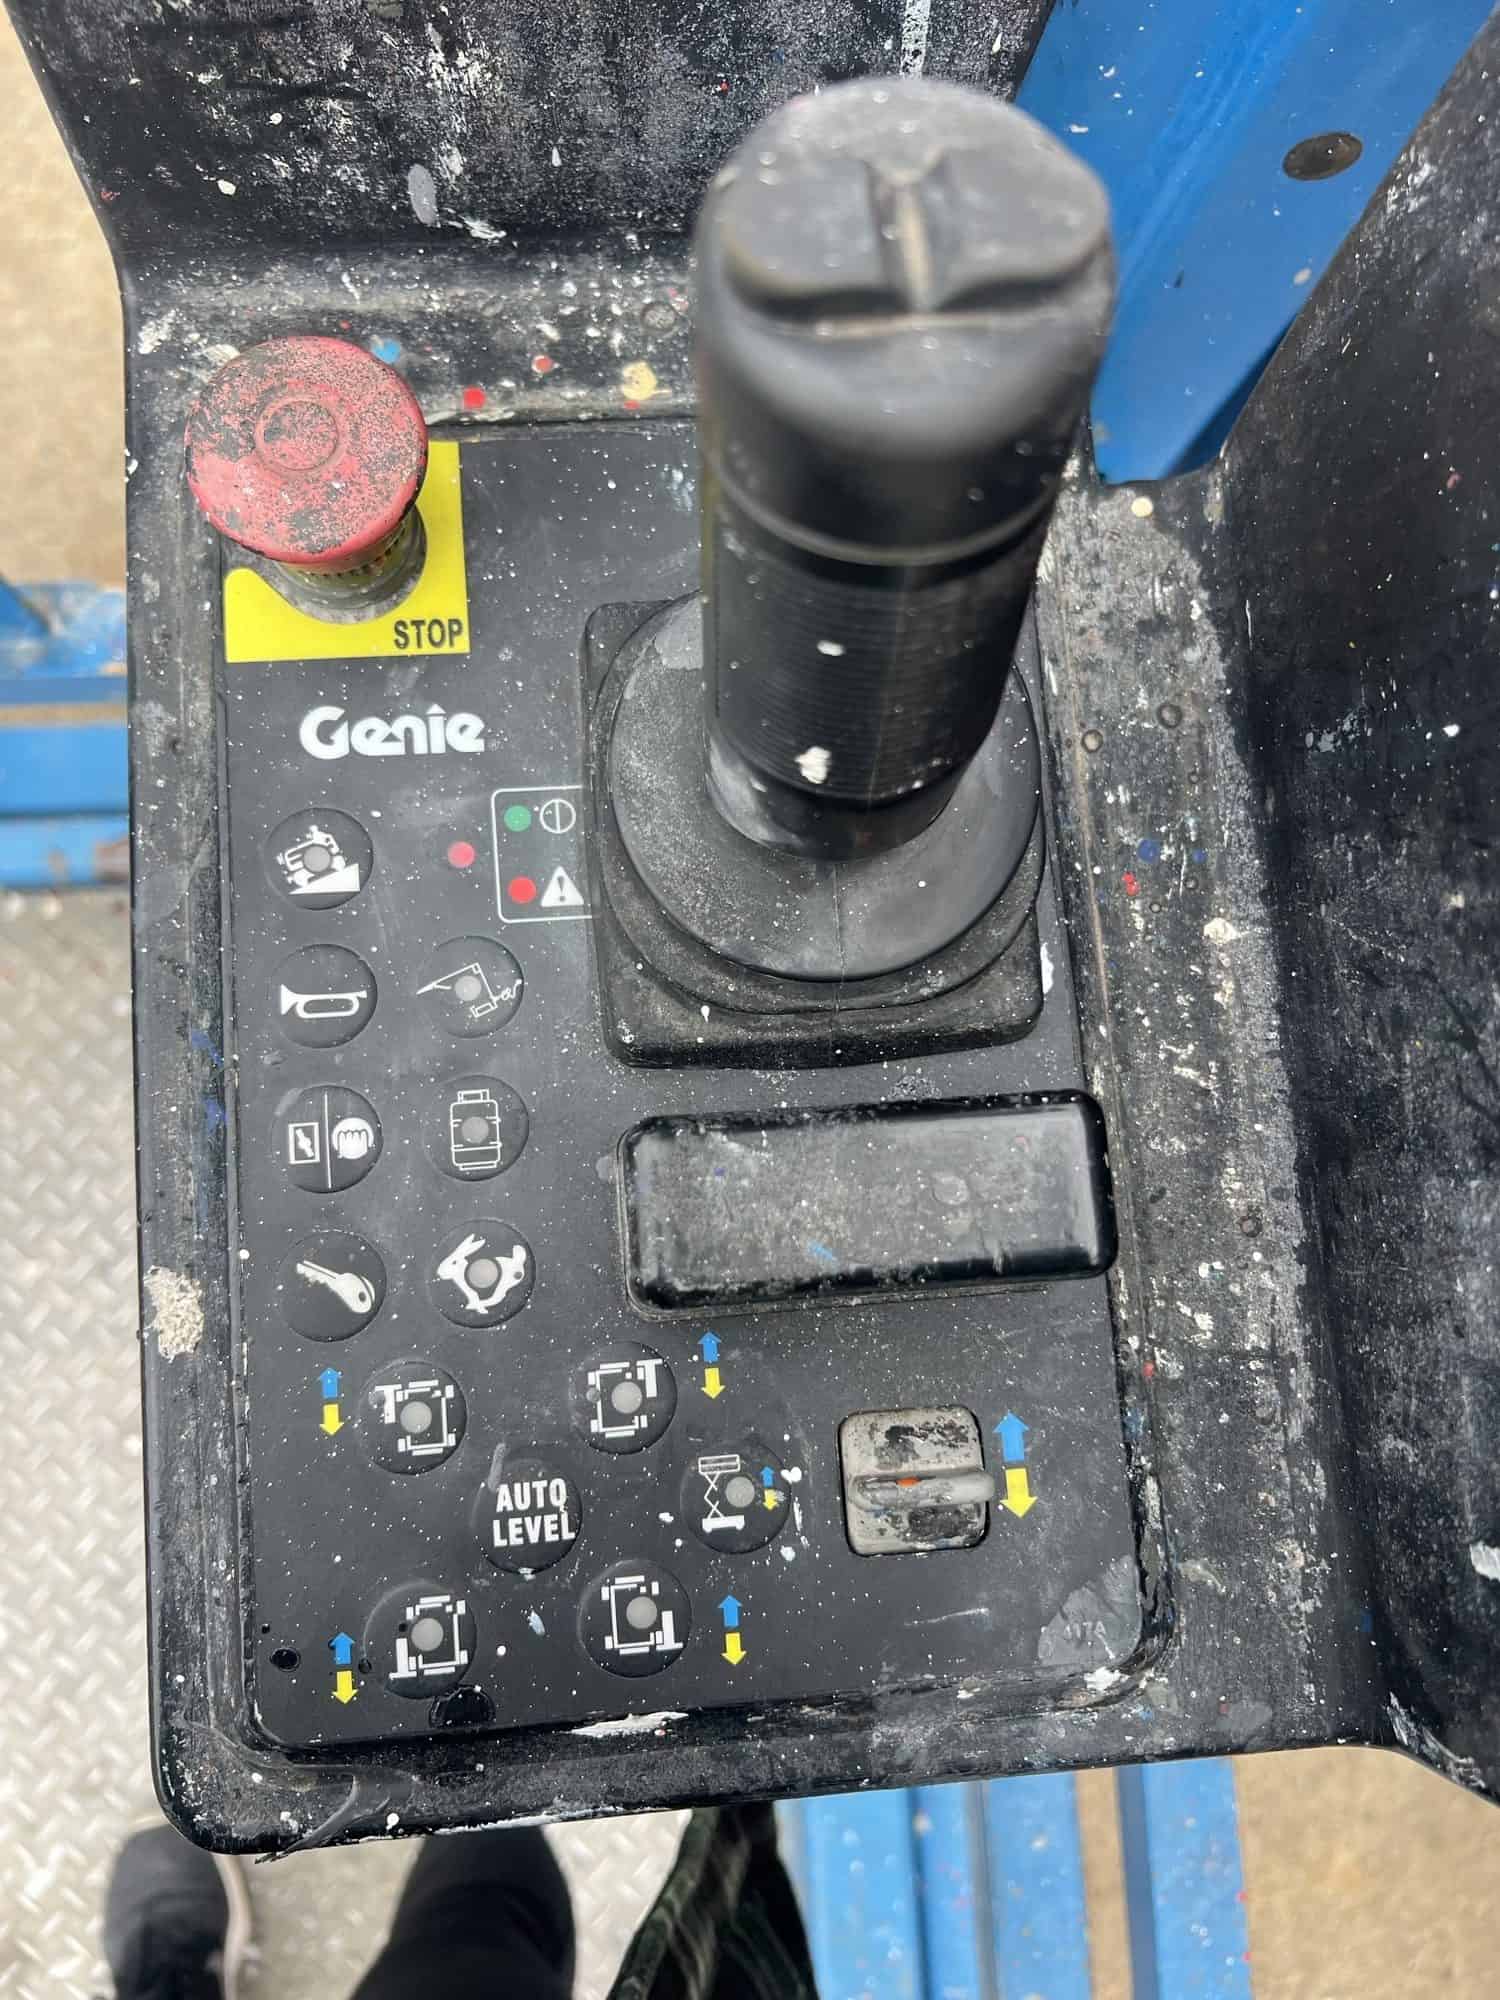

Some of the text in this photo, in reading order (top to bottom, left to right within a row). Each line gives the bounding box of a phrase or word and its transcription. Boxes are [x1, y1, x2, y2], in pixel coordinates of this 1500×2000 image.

[393, 617, 463, 650] STOP
[299, 704, 485, 760] Genie
[496, 1478, 568, 1513] AUTO
[492, 1511, 576, 1548] LEVEL
